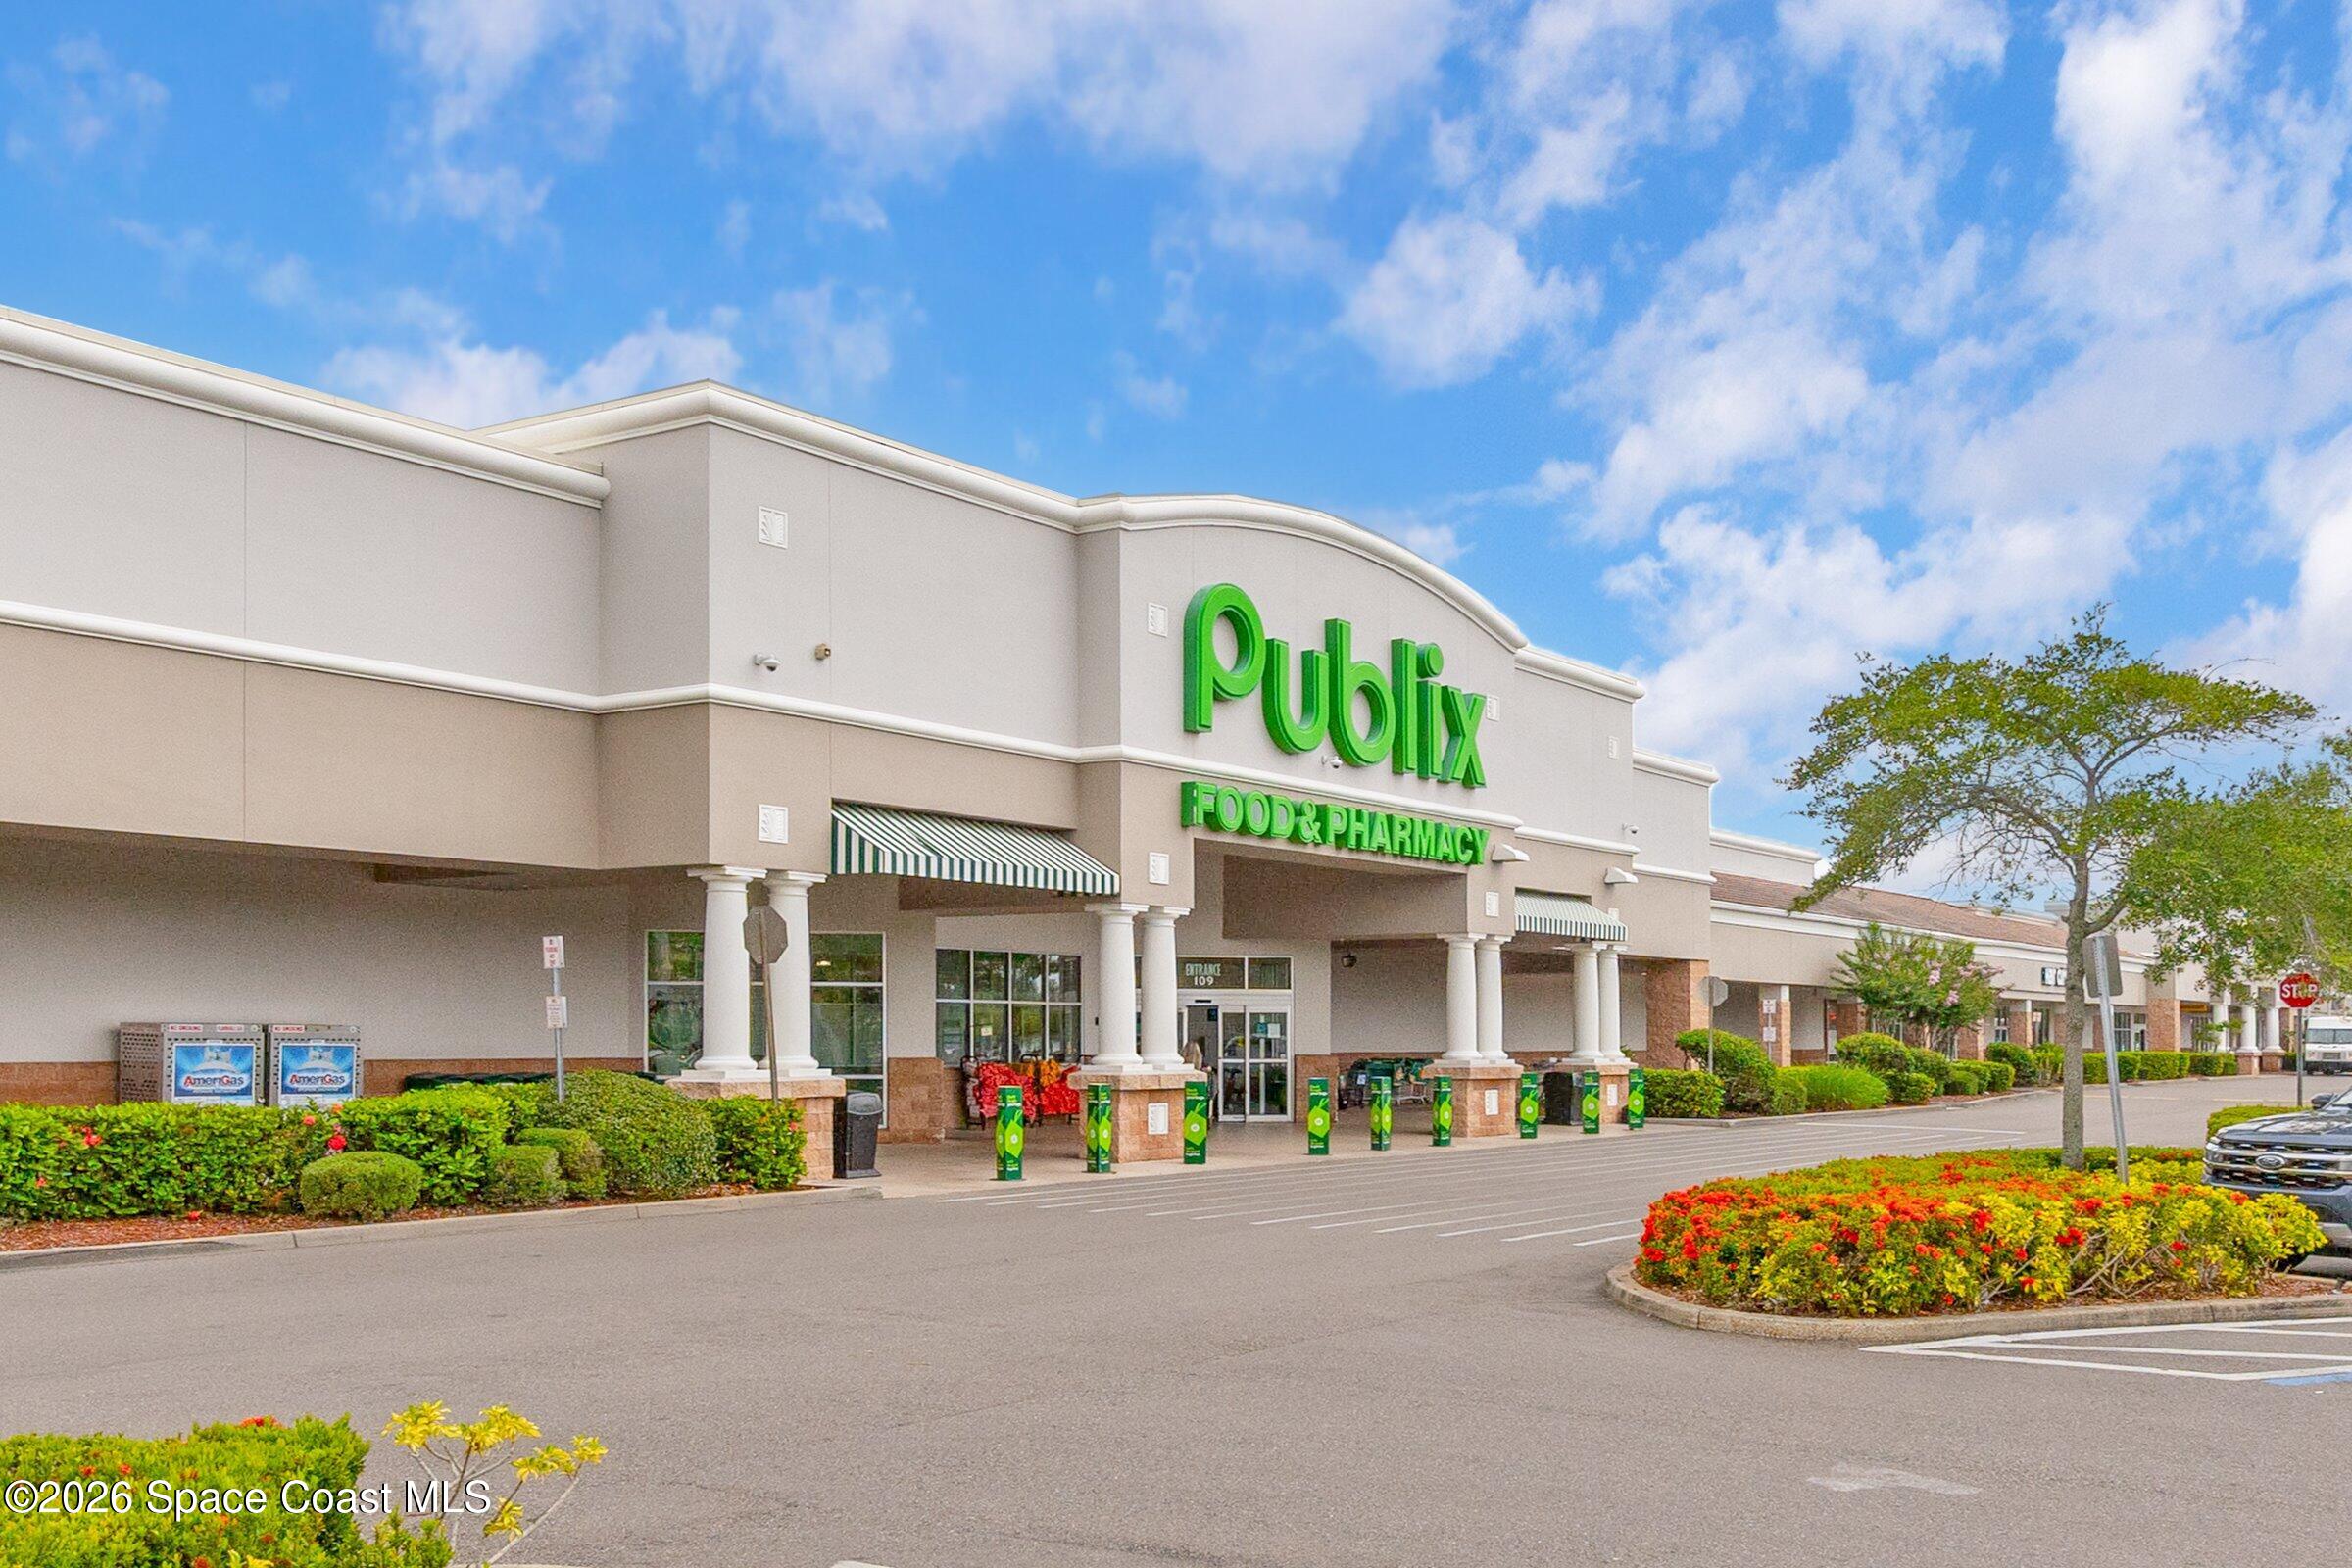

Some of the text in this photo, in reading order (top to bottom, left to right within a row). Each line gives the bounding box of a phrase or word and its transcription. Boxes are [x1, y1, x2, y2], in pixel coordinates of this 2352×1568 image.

[1183, 582, 1487, 788] Publix
[1181, 781, 1296, 839] FOOD
[1323, 802, 1491, 865] PHARMACY
[1185, 962, 1222, 977] ENTRANCE
[1193, 975, 1215, 986] 109
[183, 1075, 245, 1087] AmeriGas
[289, 1073, 345, 1085] AmeriGas
